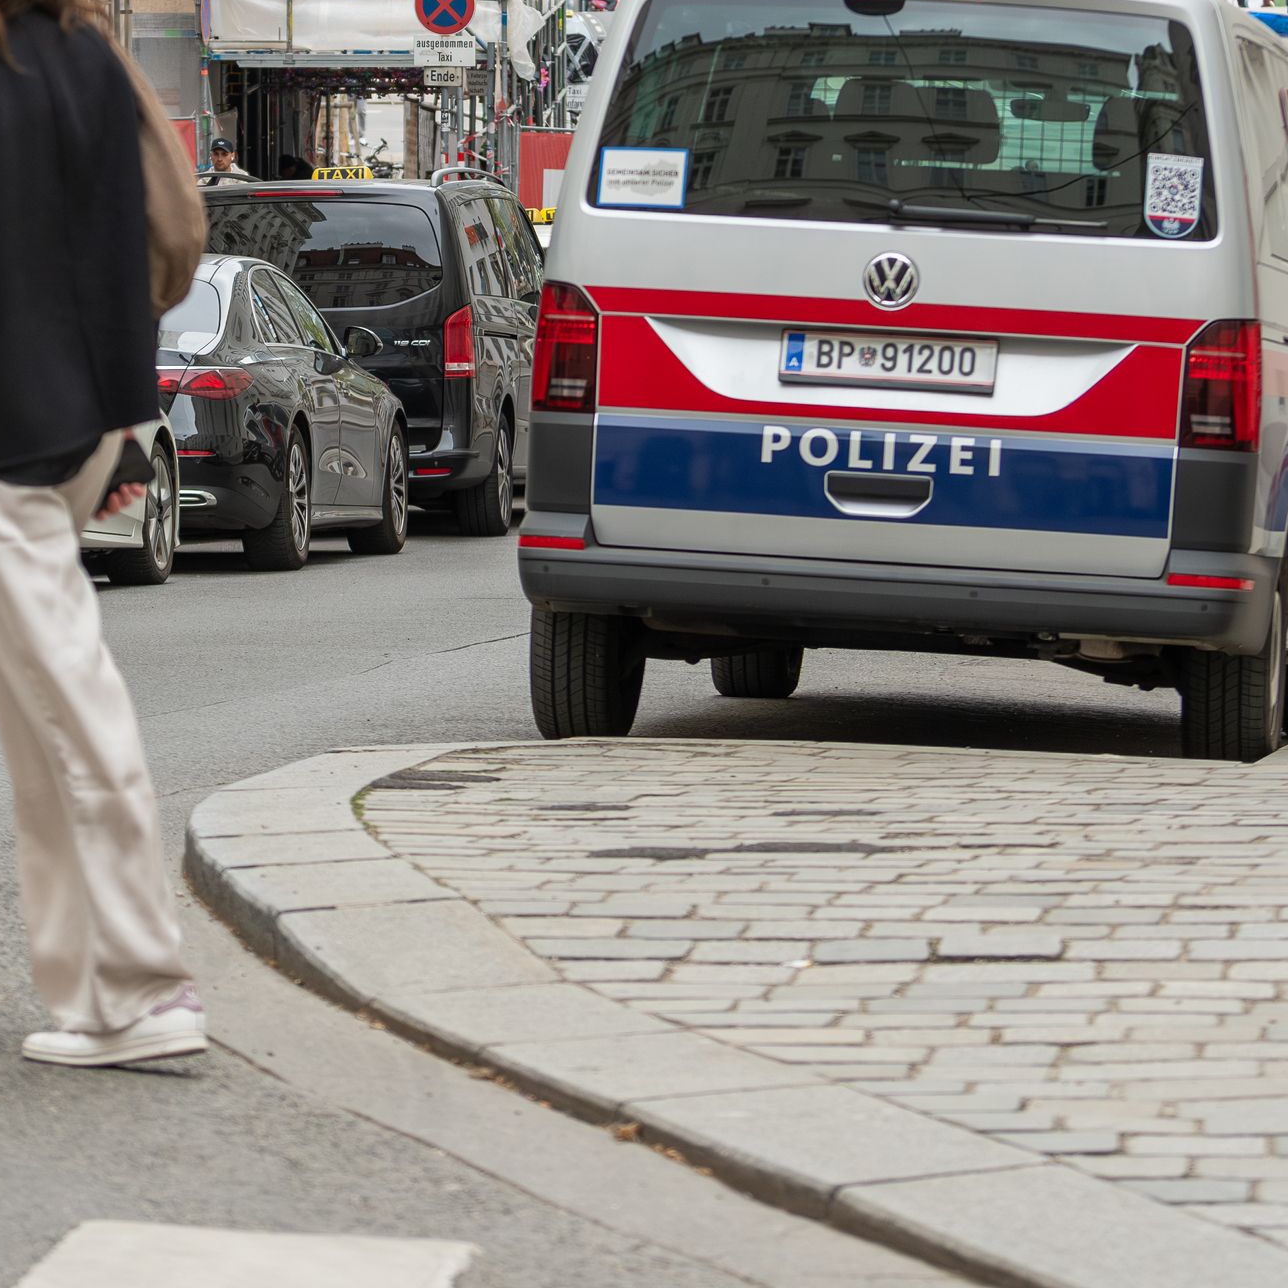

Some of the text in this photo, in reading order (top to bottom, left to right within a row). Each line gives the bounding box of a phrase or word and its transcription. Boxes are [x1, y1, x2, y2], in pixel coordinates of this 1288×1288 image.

[416, 39, 473, 50] ausgenommen
[437, 51, 453, 62] Taxi
[430, 69, 456, 82] Ende
[320, 168, 363, 180] TAXI
[815, 339, 855, 370] BP
[880, 342, 976, 377] 91200
[760, 425, 1002, 477] POLIZEI
